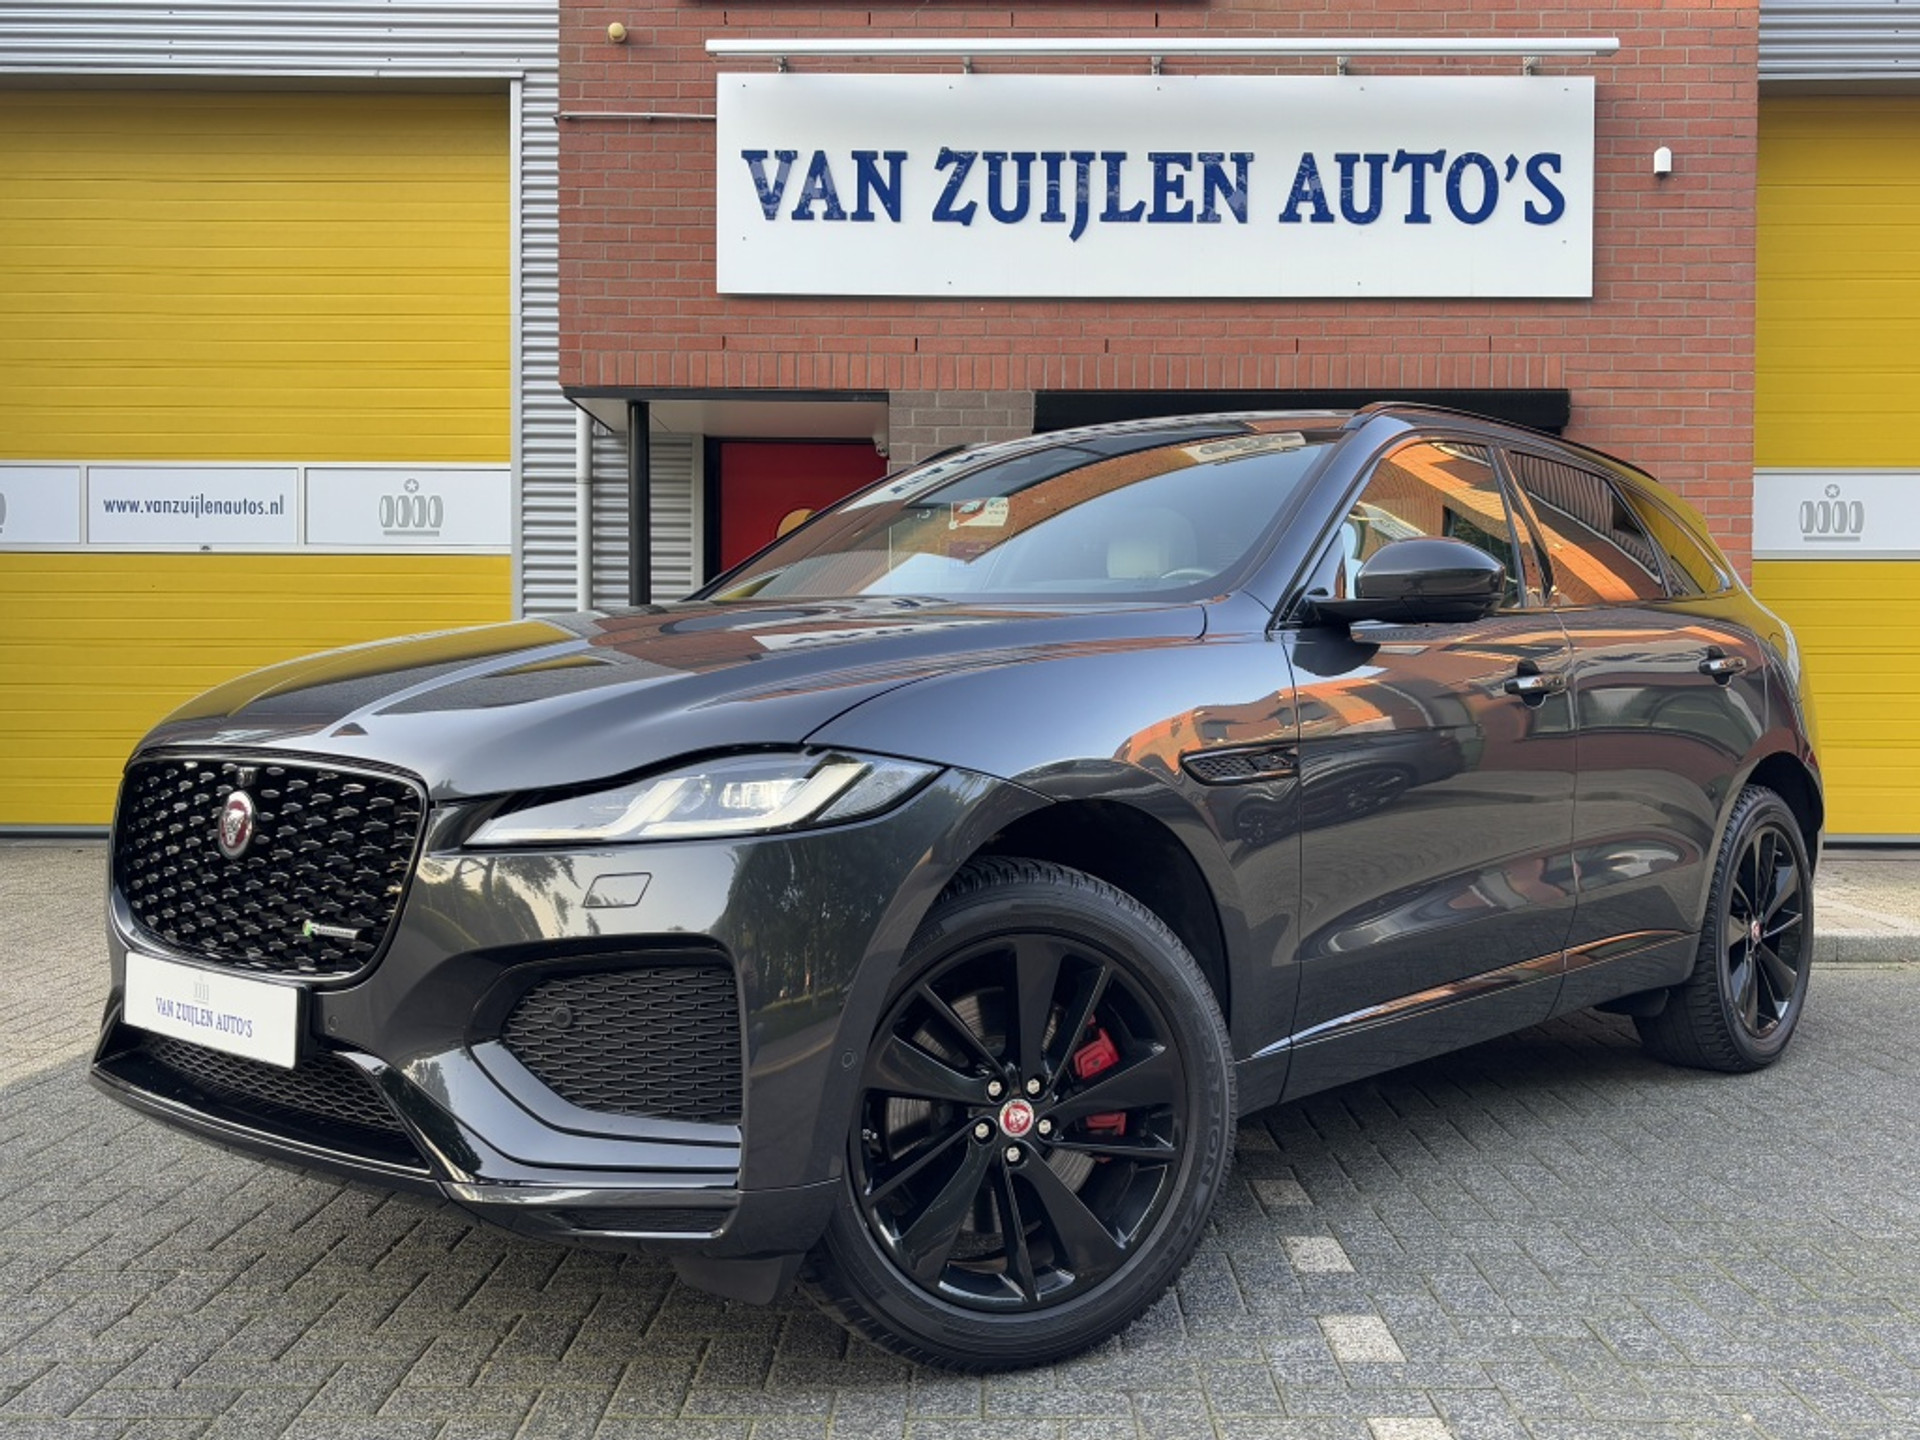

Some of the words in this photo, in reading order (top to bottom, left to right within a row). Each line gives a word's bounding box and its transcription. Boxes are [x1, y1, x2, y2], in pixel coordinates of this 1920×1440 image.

[741, 149, 908, 222] VAN
[932, 146, 1255, 242] ZUIJLEN
[1279, 149, 1566, 225] AUTO'S
[103, 493, 284, 518] www.vanzuijlenautos.nl
[156, 996, 174, 1017] VAN
[176, 1001, 213, 1027] ZUIJLEN
[216, 1013, 252, 1038] AUTO'S
